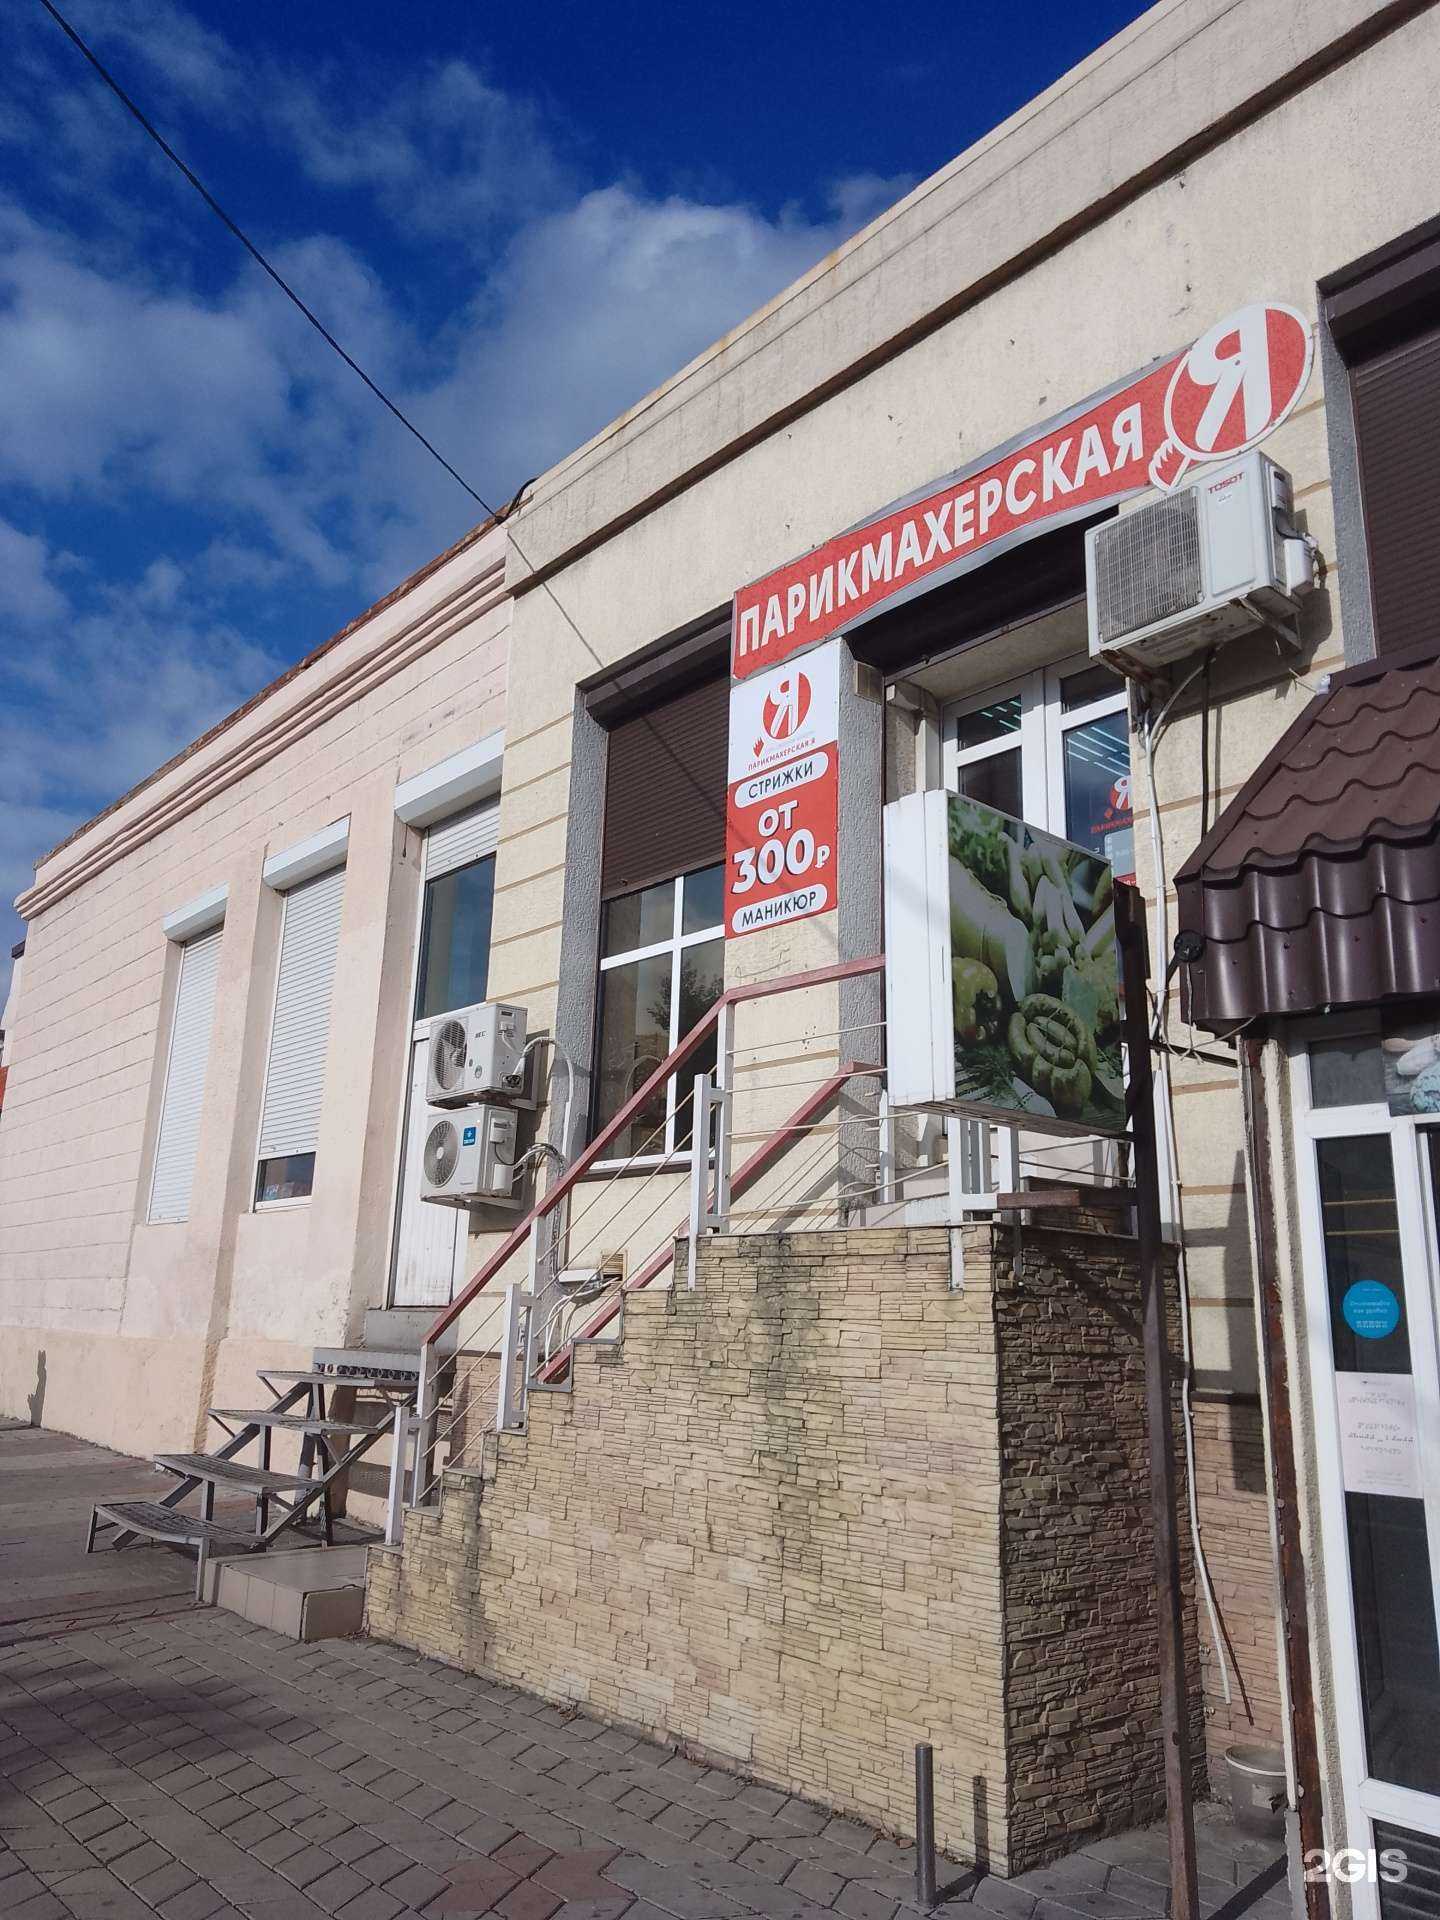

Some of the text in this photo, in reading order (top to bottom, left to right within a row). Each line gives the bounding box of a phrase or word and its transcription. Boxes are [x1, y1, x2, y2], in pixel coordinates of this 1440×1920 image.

[1207, 471, 1244, 494] TOSOT
[739, 402, 1143, 657] ПАРИКМАХЕРСКАЯ
[747, 740, 809, 770] ПАРИКМАХЕРСКАЯ
[748, 760, 813, 798] СТРИЖКИ
[741, 891, 816, 928] МАНИКЮР
